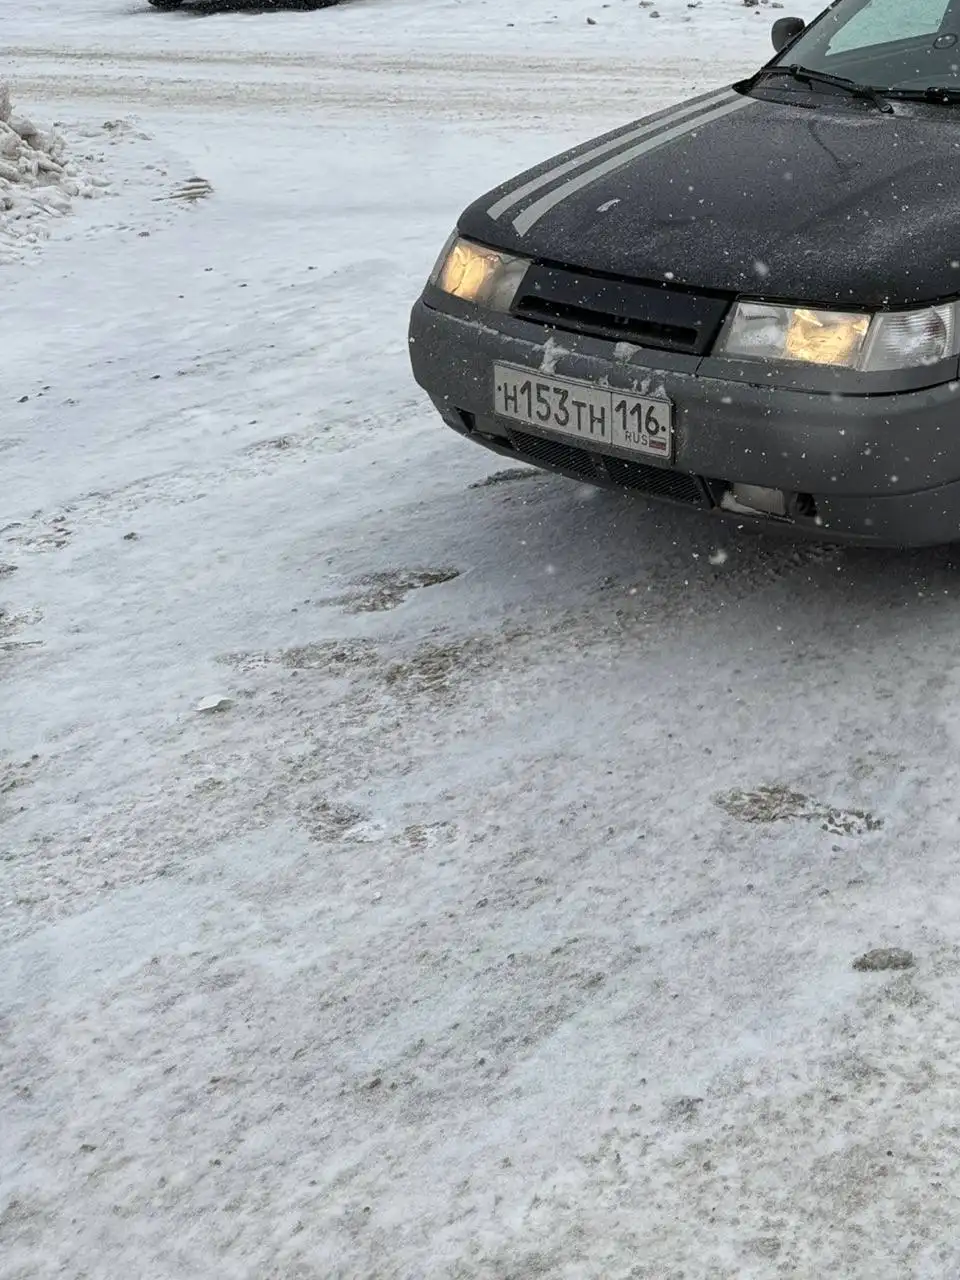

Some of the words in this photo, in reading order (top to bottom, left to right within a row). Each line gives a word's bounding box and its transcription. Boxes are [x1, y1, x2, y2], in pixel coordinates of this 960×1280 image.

[503, 380, 606, 437] Н153ТН
[614, 399, 660, 436] 116
[625, 430, 649, 447] RUS
